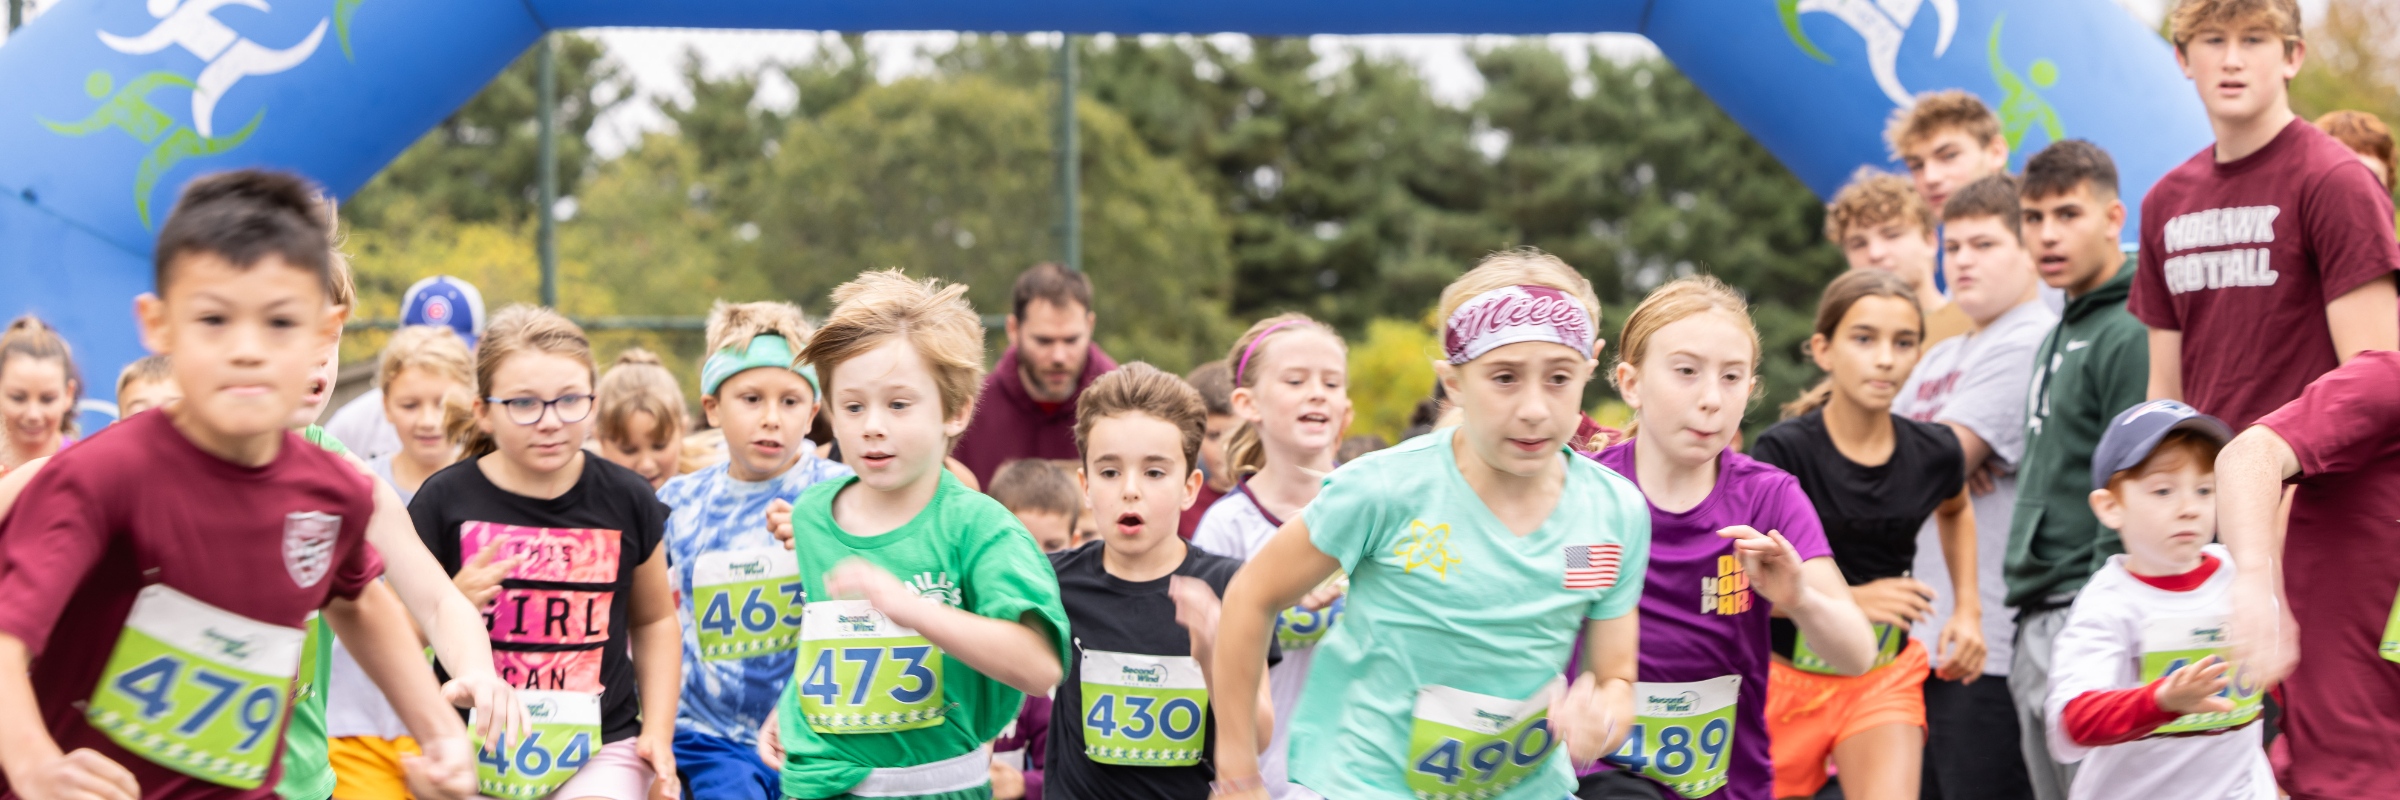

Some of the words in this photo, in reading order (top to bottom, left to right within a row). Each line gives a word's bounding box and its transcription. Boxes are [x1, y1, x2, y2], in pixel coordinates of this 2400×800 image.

[2164, 204, 2281, 254] MOHAWK
[701, 582, 804, 637] 463
[503, 666, 566, 690] CAN
[801, 645, 937, 706] 473
[1122, 665, 1156, 675] Second
[112, 655, 283, 755] 479
[1085, 693, 1202, 741] 430
[477, 730, 592, 778] 464
[1412, 716, 1557, 786] 490
[1604, 717, 1730, 777] 489
